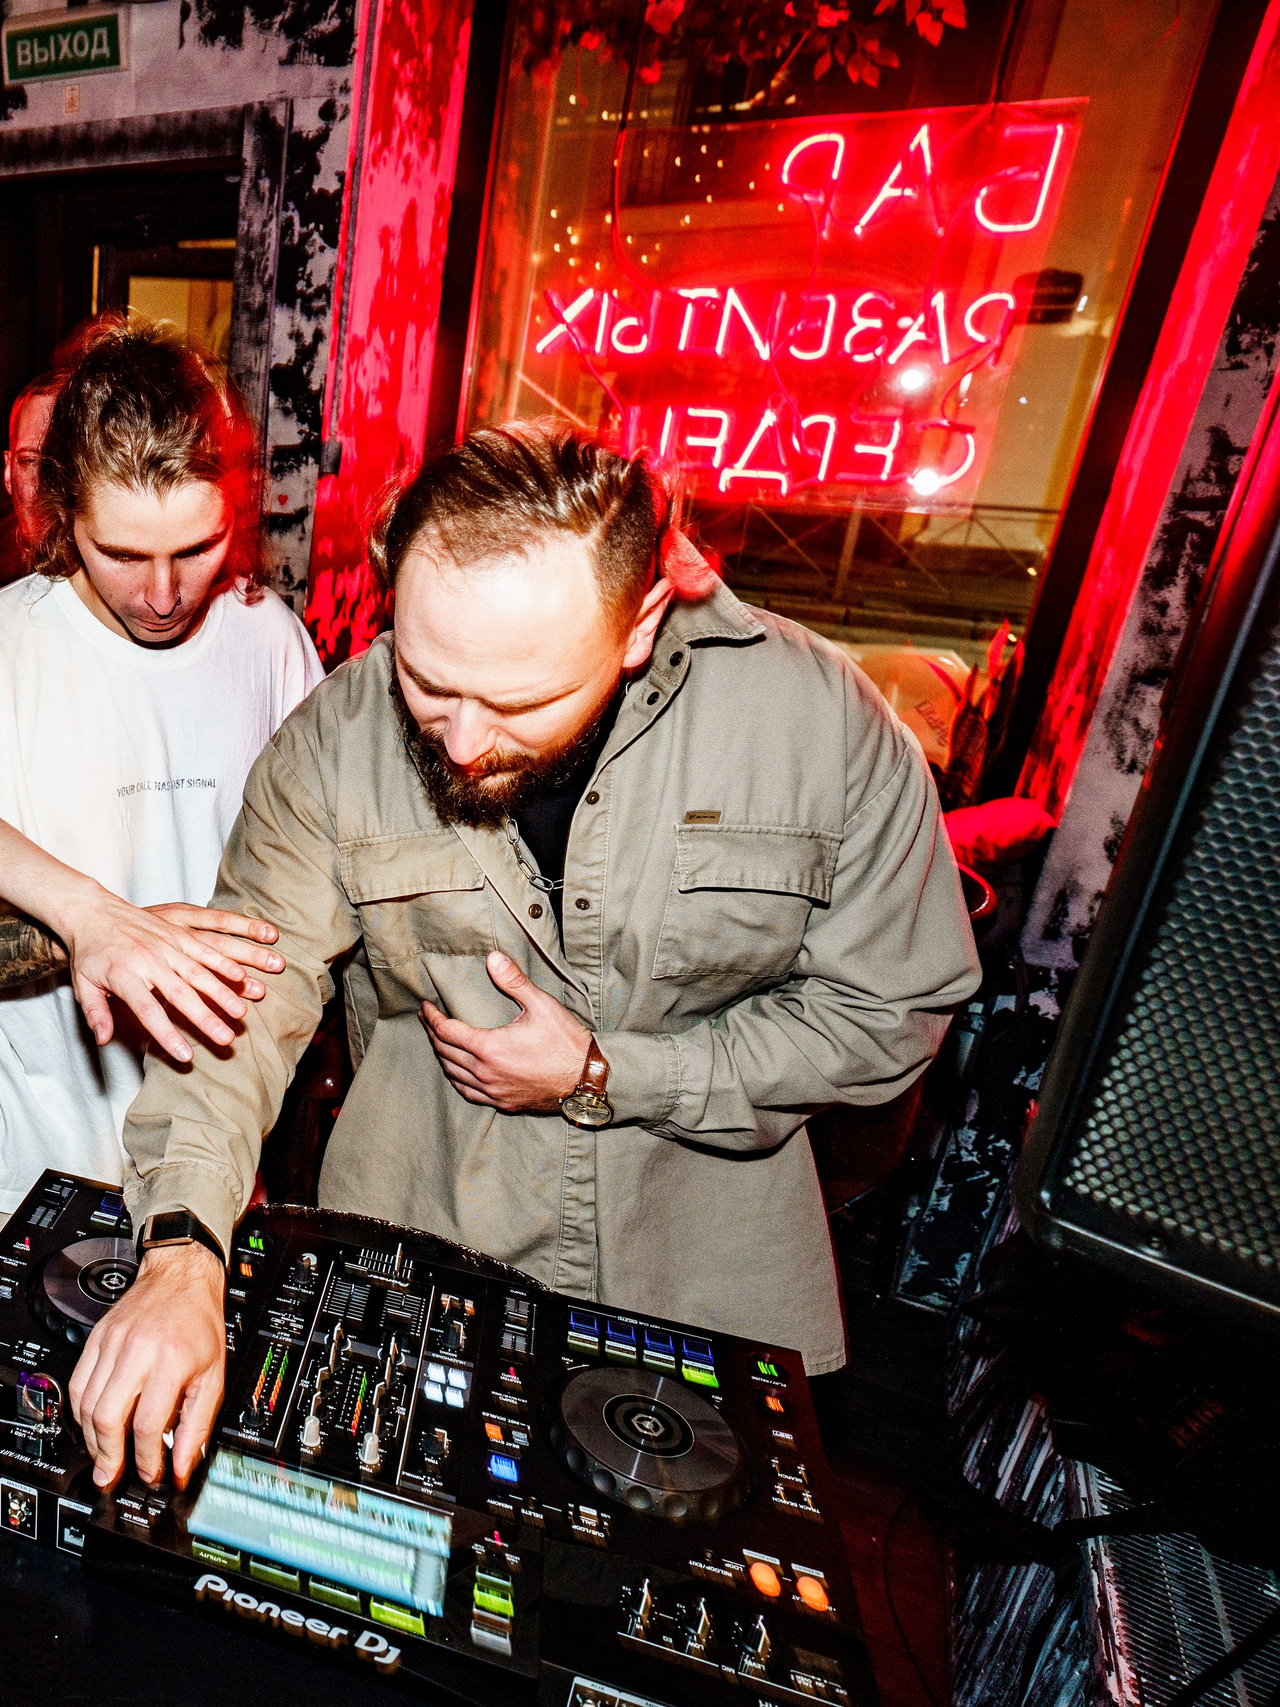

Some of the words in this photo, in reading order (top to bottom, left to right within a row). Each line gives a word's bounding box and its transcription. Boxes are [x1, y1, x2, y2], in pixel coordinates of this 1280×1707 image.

[17, 27, 110, 66] ВЫХОД
[117, 784, 135, 797] YOUR
[136, 780, 152, 793] CALL
[154, 781, 171, 791] HAS
[170, 778, 185, 790] OST
[187, 778, 217, 788] SIGNAL
[505, 1441, 520, 1449] BEAT
[424, 1456, 438, 1465] TRIM
[777, 1472, 803, 1483] SEARCH
[6, 1480, 27, 1491] MASTER
[486, 1498, 513, 1510] MEMORY
[771, 1495, 798, 1508] SEARCH
[520, 1507, 543, 1519] DELETE
[797, 1502, 820, 1513] TRACK
[132, 1515, 148, 1524] DECK
[571, 1523, 604, 1537] CUE/LOOP
[198, 1551, 221, 1562] UTILITY
[688, 1558, 733, 1578] RELOOP/EXIT
[724, 1562, 743, 1571] LOOP
[193, 1573, 350, 1641] Pioneer
[353, 1629, 403, 1666] DJ
[662, 1635, 673, 1643] EQ
[720, 1663, 736, 1674] MIC
[590, 1682, 604, 1691] AUX
